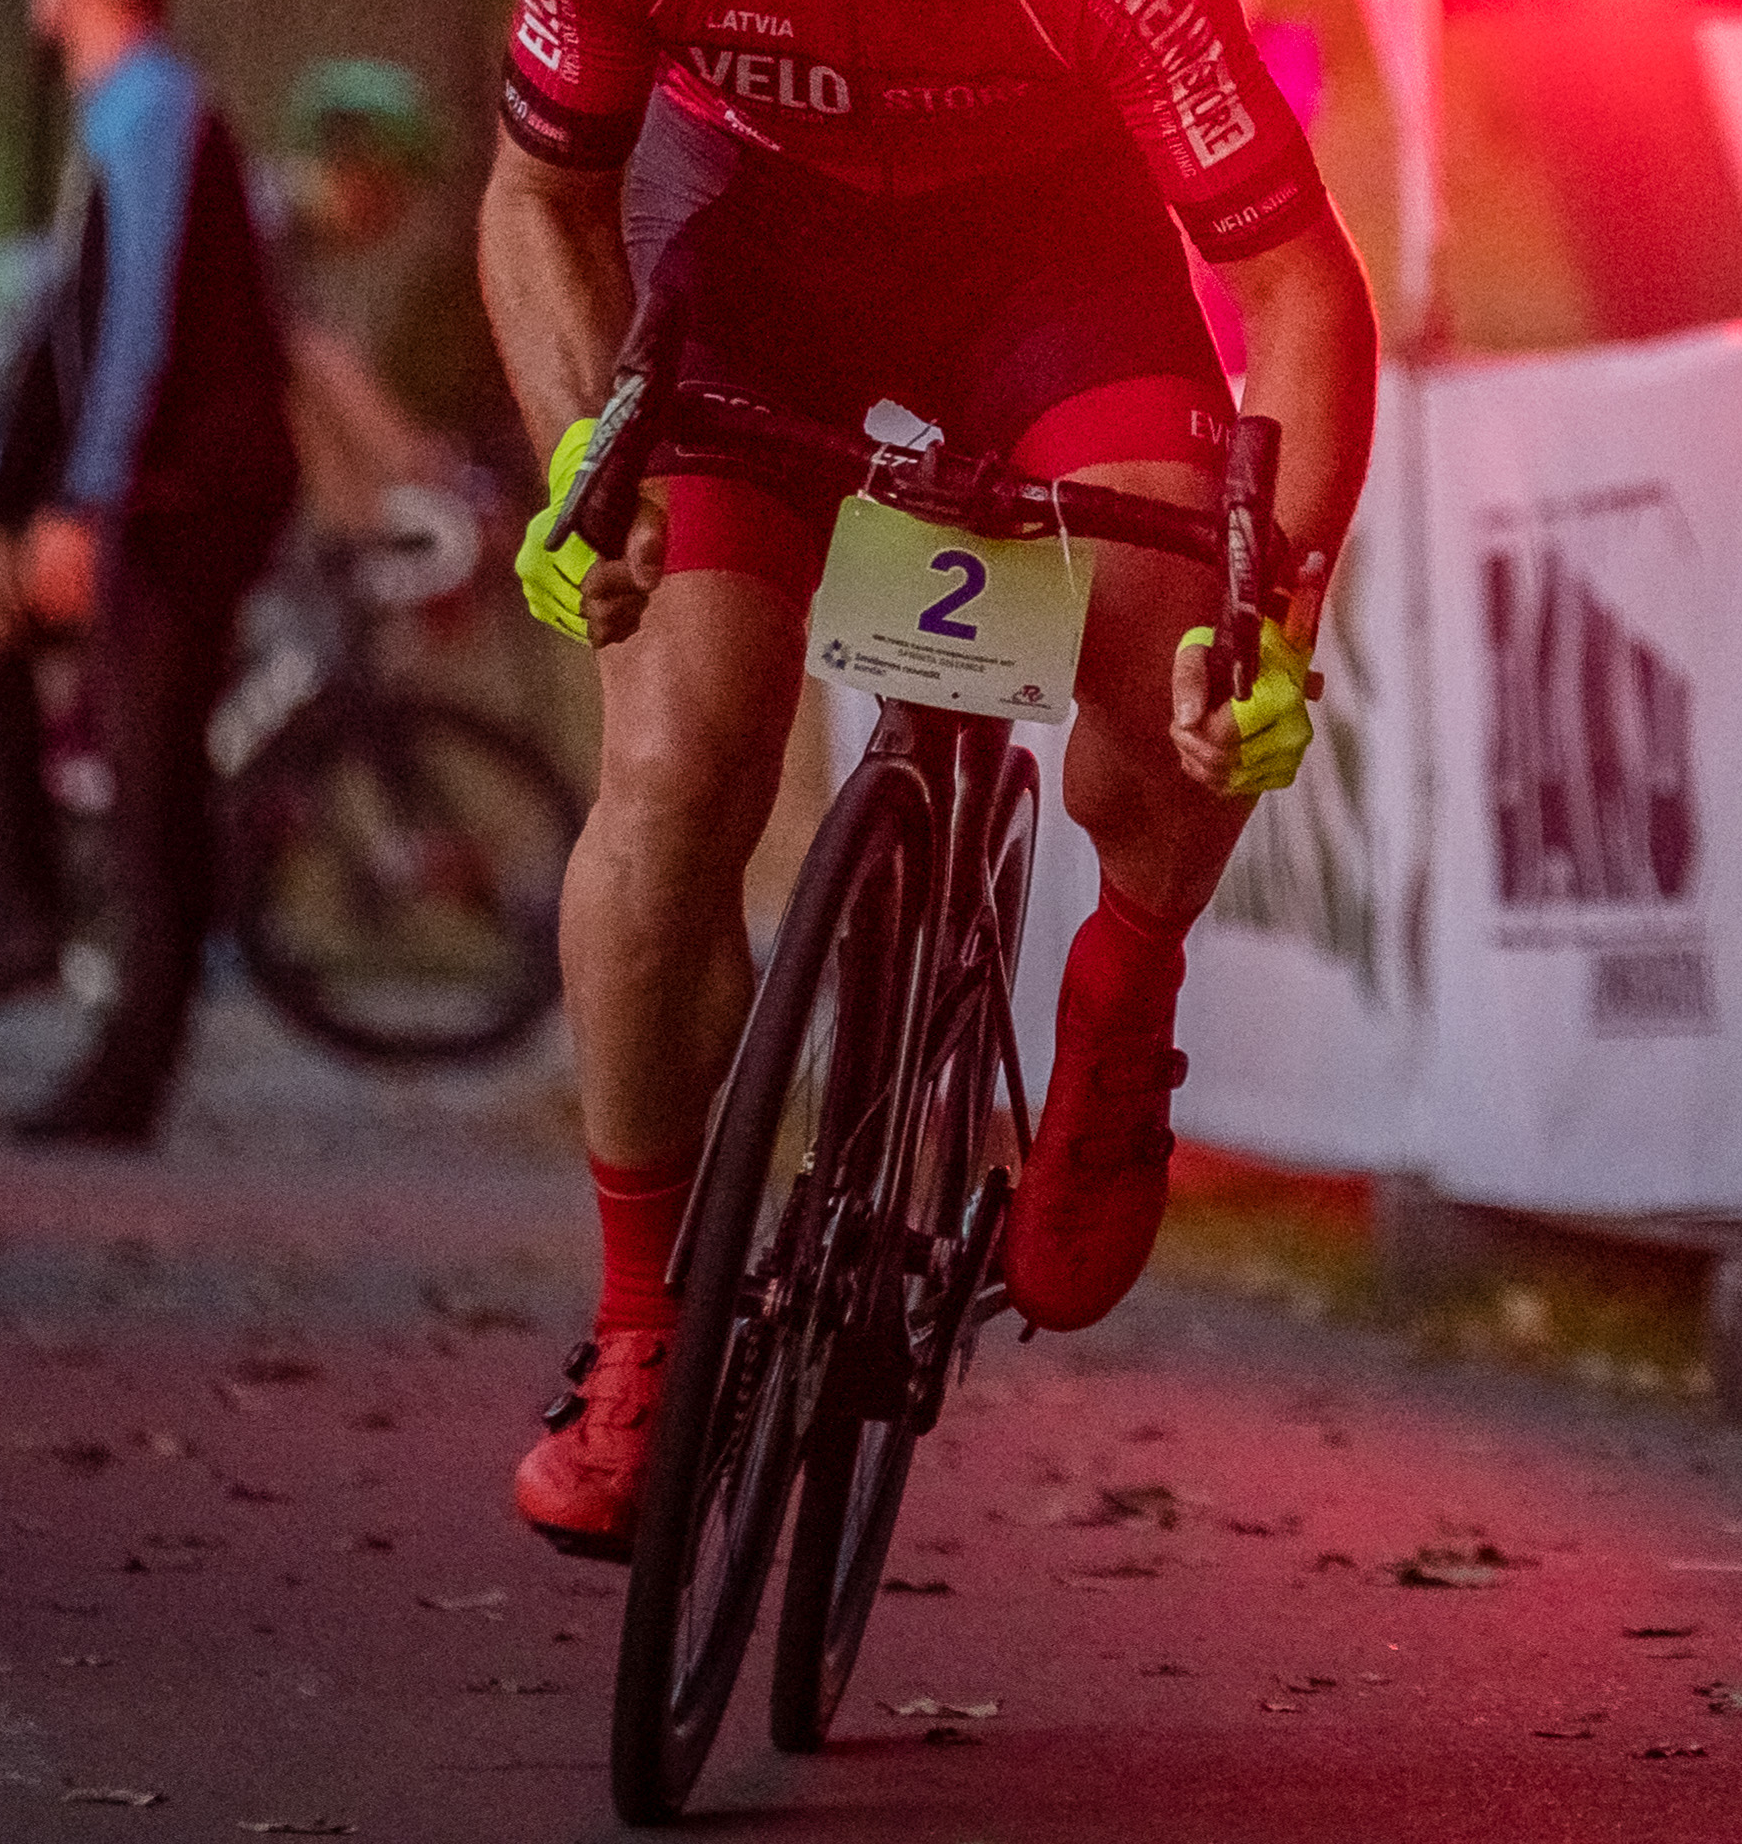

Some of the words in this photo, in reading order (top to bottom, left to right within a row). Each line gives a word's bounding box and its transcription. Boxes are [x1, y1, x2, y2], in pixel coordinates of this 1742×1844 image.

[708, 10, 794, 38] LATVIA
[688, 47, 852, 114] VELO
[917, 550, 988, 640] 2
